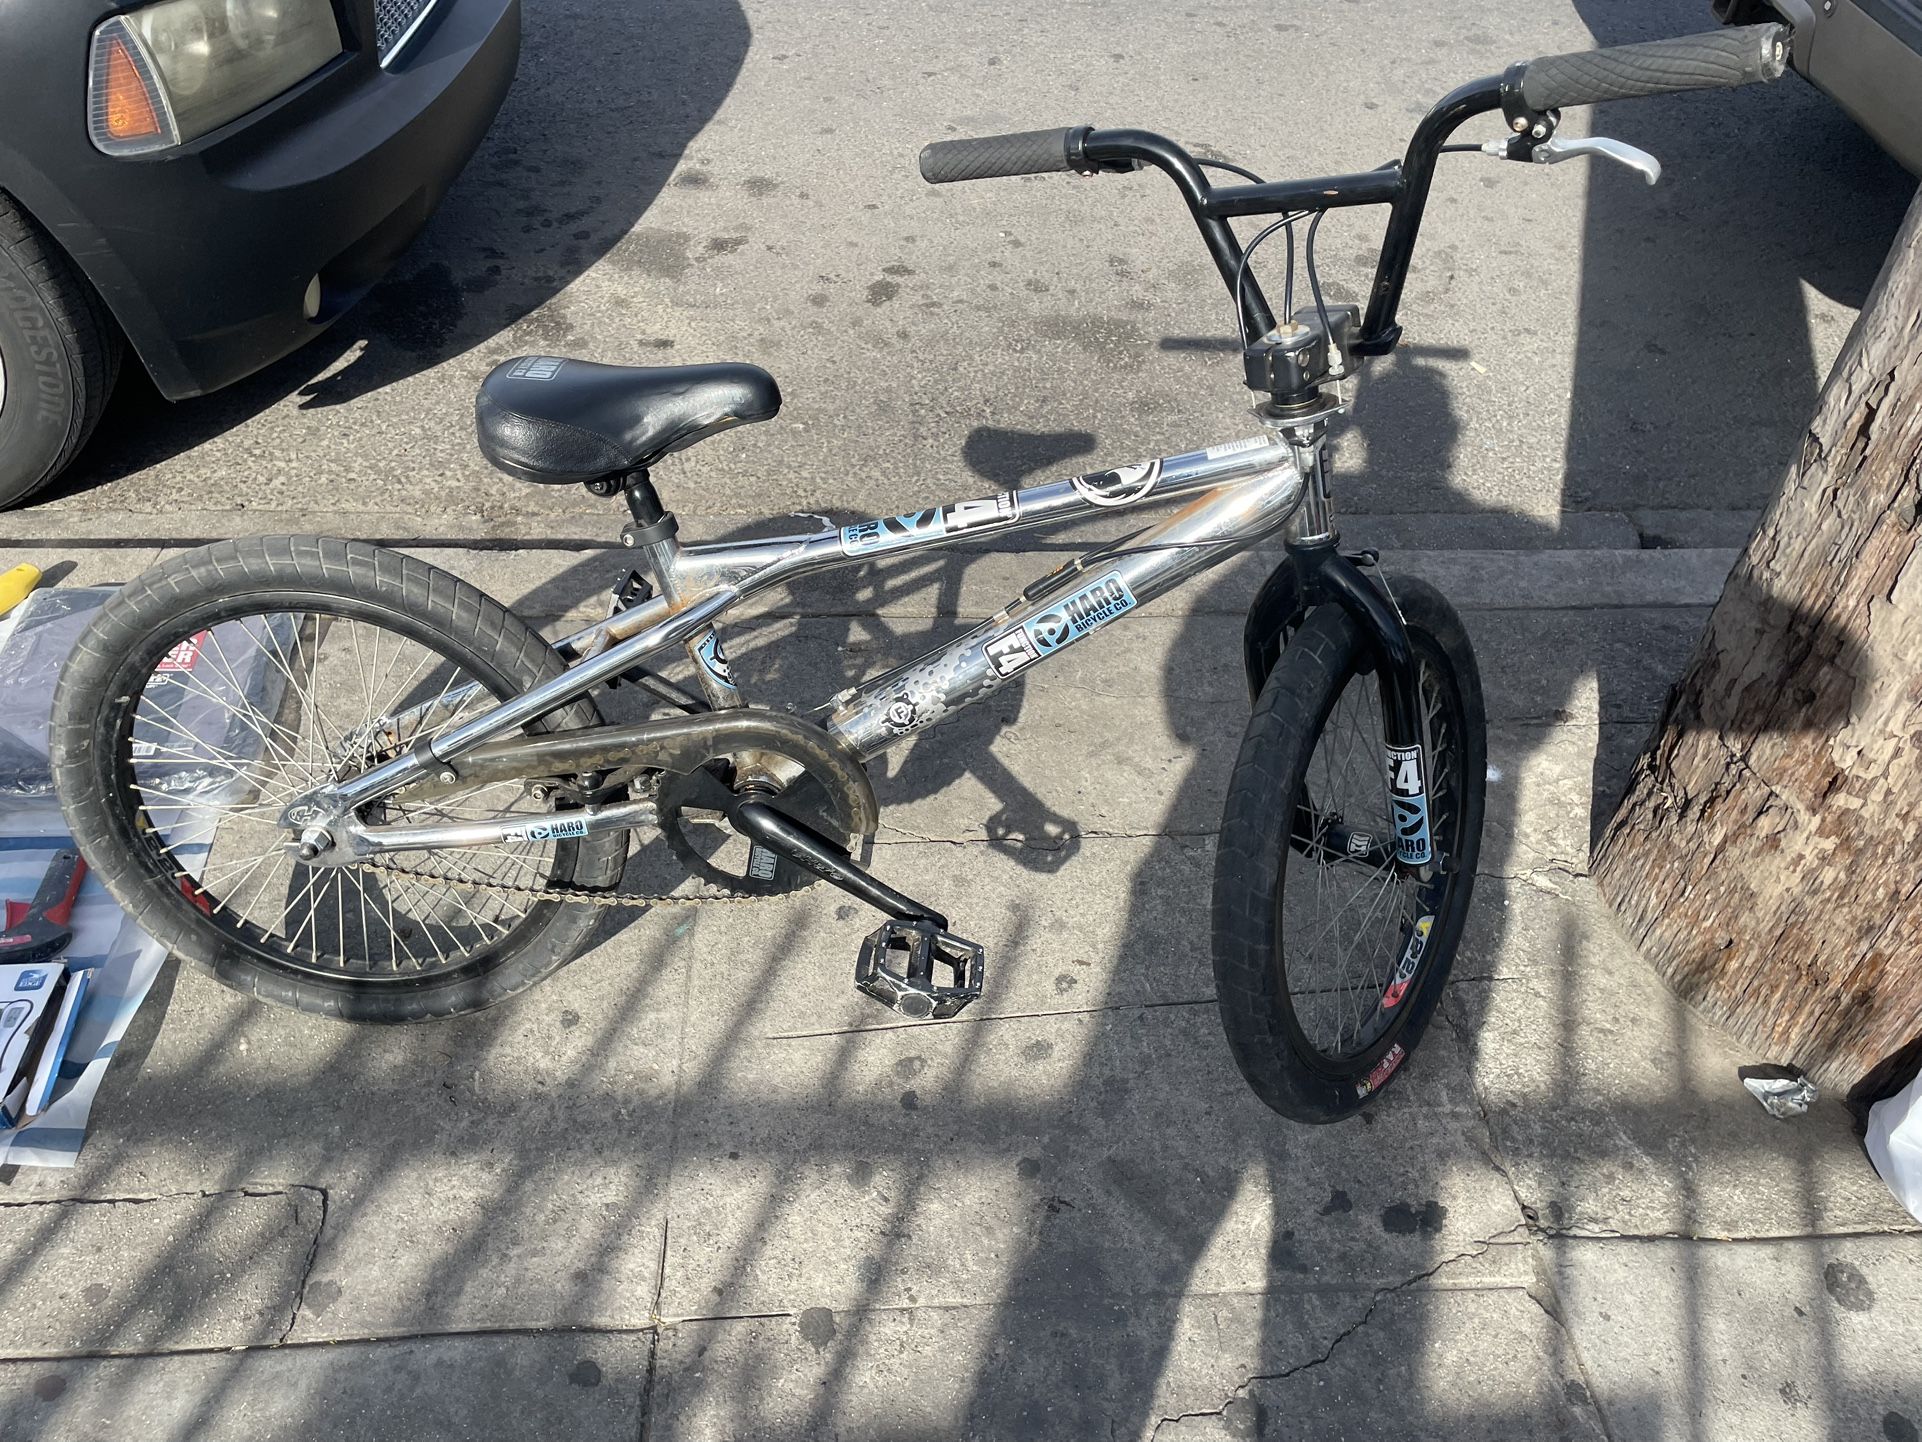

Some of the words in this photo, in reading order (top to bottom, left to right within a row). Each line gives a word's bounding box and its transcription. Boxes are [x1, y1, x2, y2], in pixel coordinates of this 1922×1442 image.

[947, 499, 999, 529] 4
[1063, 578, 1125, 625] HARO
[1075, 606, 1115, 633] BICYCLE
[986, 632, 1031, 676] F4
[1014, 627, 1039, 660] FUNCTION
[551, 820, 584, 834] HARO
[1398, 838, 1426, 853] ARO
